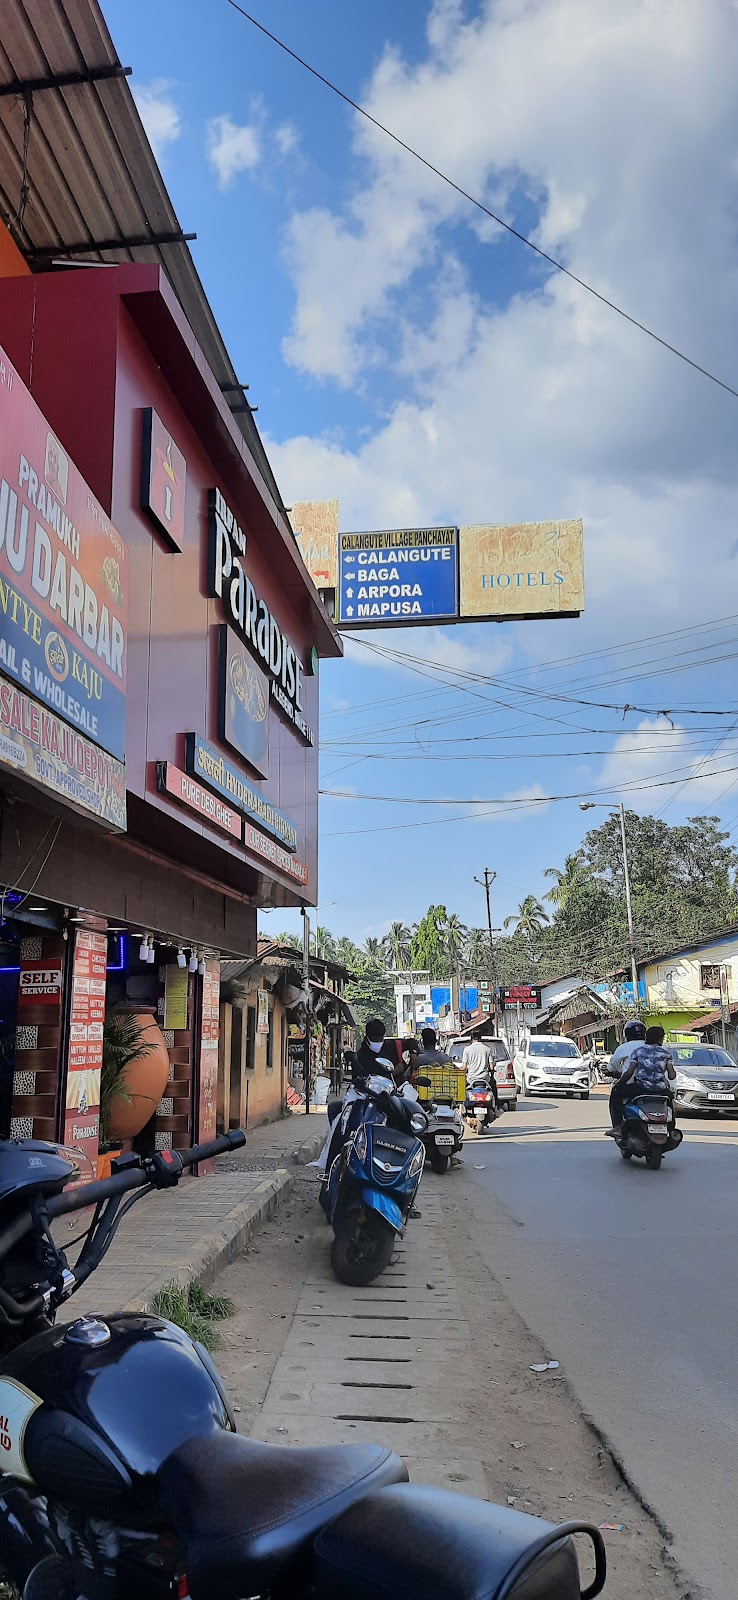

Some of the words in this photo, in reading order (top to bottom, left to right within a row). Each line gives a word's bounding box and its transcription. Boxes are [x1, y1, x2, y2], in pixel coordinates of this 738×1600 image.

[18, 453, 80, 561] PRAMUKH
[341, 533, 383, 551] CALANGUTE
[384, 531, 414, 548] VILLAGE
[414, 529, 455, 546] PANCHAYAT
[357, 547, 452, 565] CALANGUTE
[357, 567, 400, 583] BAGA
[481, 571, 565, 589] HOTELS
[32, 521, 124, 679] DARBAR
[357, 583, 423, 599] ARPORA
[357, 601, 422, 617] MAPUSA
[71, 651, 104, 701] KAJU
[22, 658, 31, 684] &
[34, 666, 98, 737] WHOLESALE
[41, 711, 75, 768] KAJU
[76, 737, 111, 791] DEPOT
[55, 767, 86, 801] APPROVED
[86, 786, 101, 810] SHOP
[181, 777, 200, 805] PURE
[201, 793, 216, 818] DESI
[216, 803, 232, 829] GHEE
[226, 771, 274, 829] HYDERABADI
[274, 813, 297, 845] BIRYANI
[22, 972, 58, 984] SELF
[21, 986, 58, 995] SERVICE
[71, 1045, 86, 1055] MUTTON
[88, 1045, 102, 1053] GRILLED
